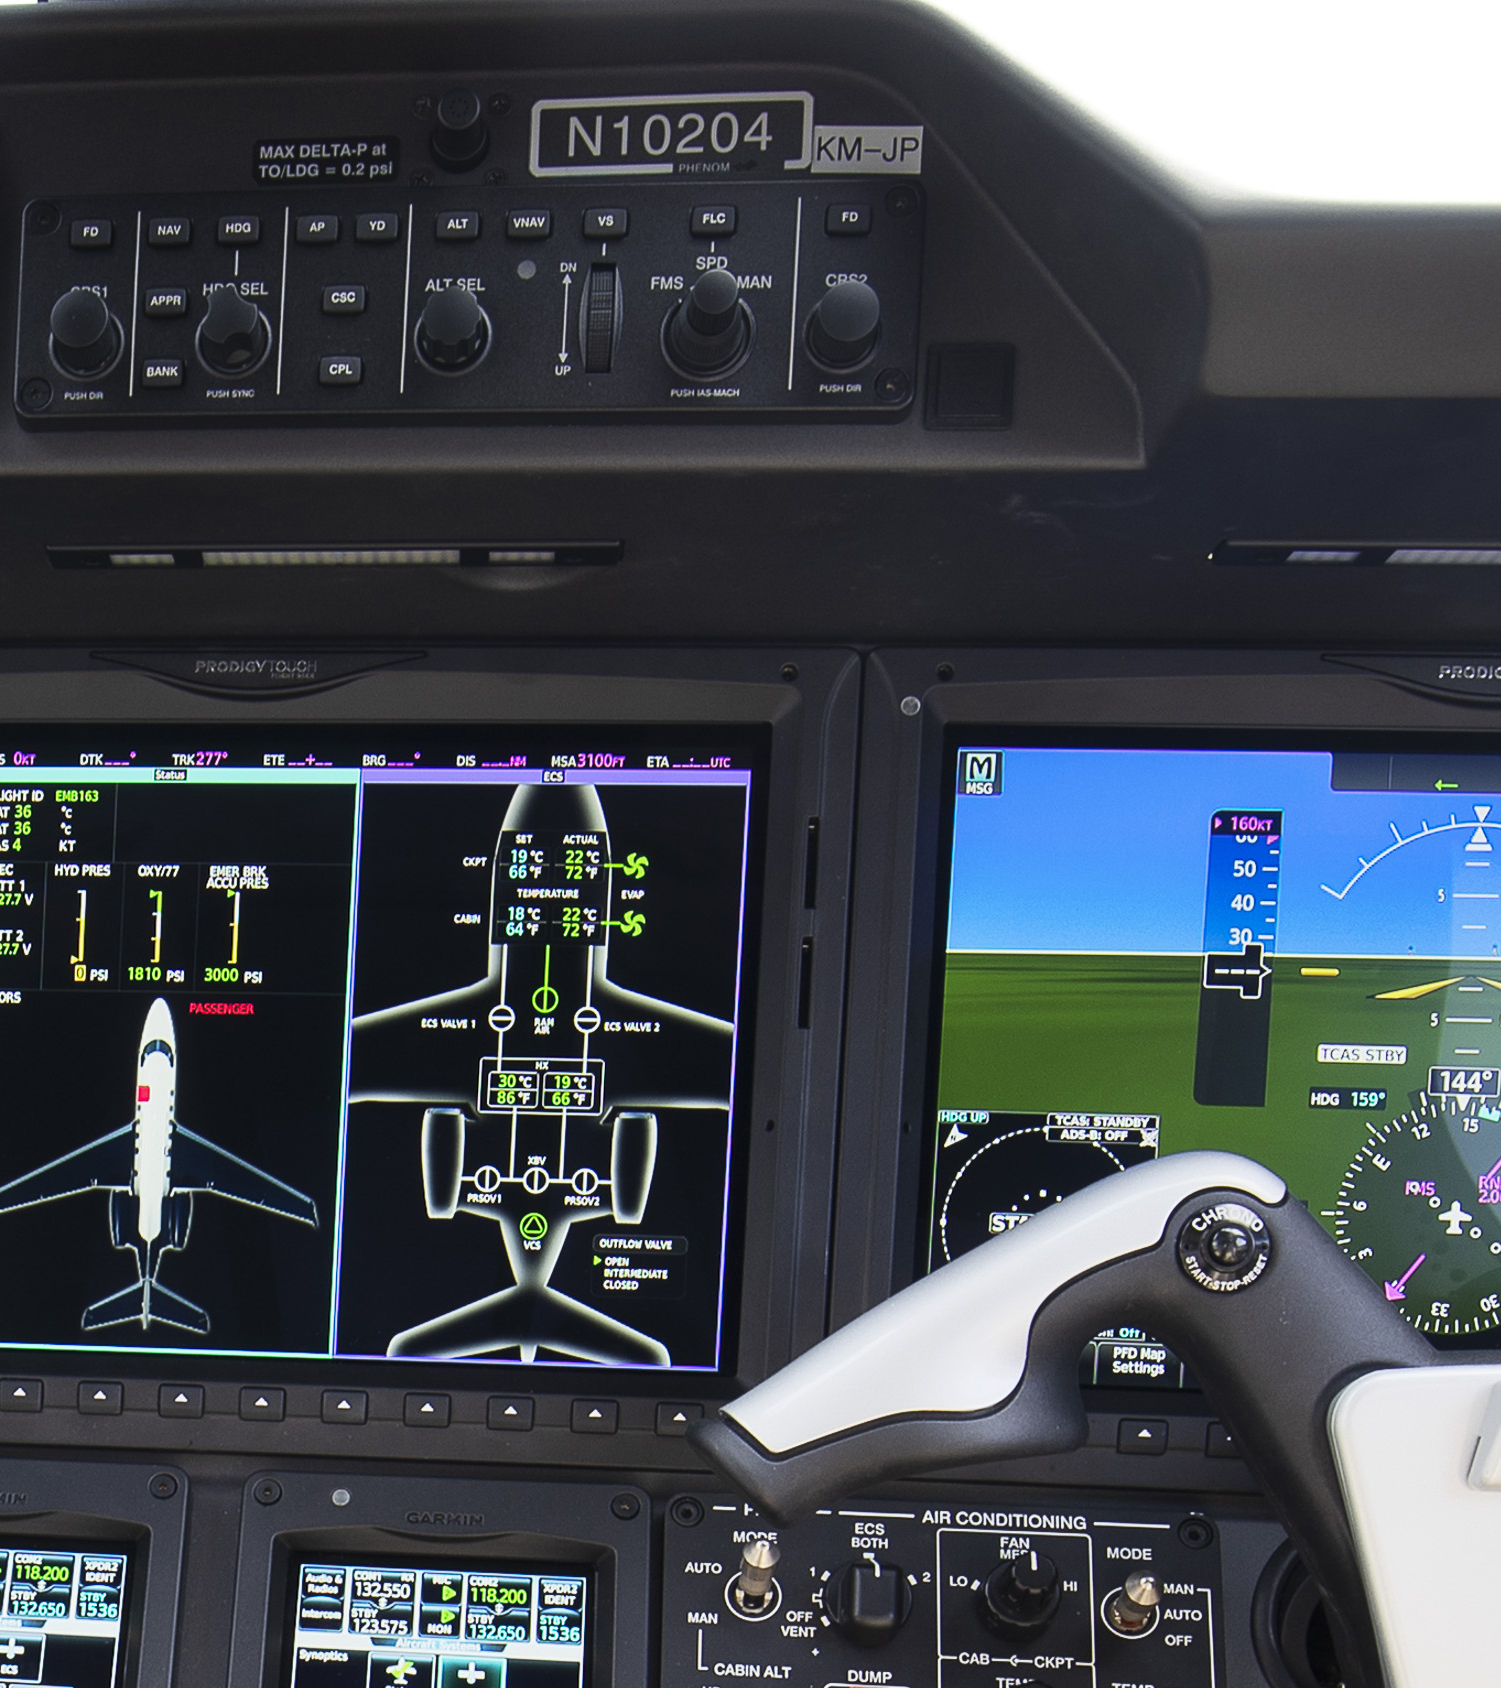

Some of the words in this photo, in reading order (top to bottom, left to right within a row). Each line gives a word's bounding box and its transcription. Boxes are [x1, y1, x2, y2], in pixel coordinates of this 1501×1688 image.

[568, 112, 773, 156] N10204
[260, 146, 295, 159] MAX
[300, 143, 367, 157] DELTA-P
[371, 143, 387, 156] at
[816, 136, 919, 162] KM-JP
[259, 164, 320, 178] TO/LDG
[342, 163, 365, 176] 0.2
[370, 161, 392, 176] psi
[679, 162, 731, 174] PHENOM
[447, 218, 468, 230] ALT
[513, 216, 545, 229] VNAV
[598, 215, 614, 227] VS
[703, 212, 726, 225] FLC
[83, 226, 98, 237] FD
[158, 225, 181, 236] NAV
[225, 222, 251, 234] HDG
[309, 221, 325, 232] AP
[369, 220, 386, 231] YD
[696, 256, 728, 270] SPD
[650, 276, 684, 290] FMS
[737, 275, 772, 289] MAN
[151, 294, 181, 307] APPR
[147, 366, 177, 378] BANK
[329, 363, 352, 375] CPL
[965, 782, 993, 794] MSG
[32, 791, 44, 802] ID
[56, 791, 99, 802] EMB163
[563, 835, 599, 845] ACTUAL
[55, 865, 80, 876] HYD
[82, 865, 110, 877] PRES
[189, 1003, 254, 1015] PASSENGER
[1321, 1048, 1360, 1062] TCAS
[1366, 1048, 1404, 1063] STBY
[600, 1239, 642, 1249] OUTFLOW
[644, 1240, 672, 1250] VALVE
[1113, 1347, 1135, 1360] PFD
[1140, 1348, 1166, 1362] Map
[1112, 1361, 1165, 1376] Settings
[922, 1511, 951, 1526] AIR
[956, 1512, 1087, 1530] CONDITIONING
[855, 1524, 885, 1535] ECS
[851, 1536, 888, 1550] BOTH
[80, 1602, 118, 1618] 1536
[353, 1619, 408, 1634] 123.575
[469, 1625, 525, 1640] 132.650
[781, 1626, 817, 1638] VENT
[713, 1664, 759, 1677] CABIN
[763, 1666, 791, 1678] ALT
[847, 1670, 892, 1683] DUMP
